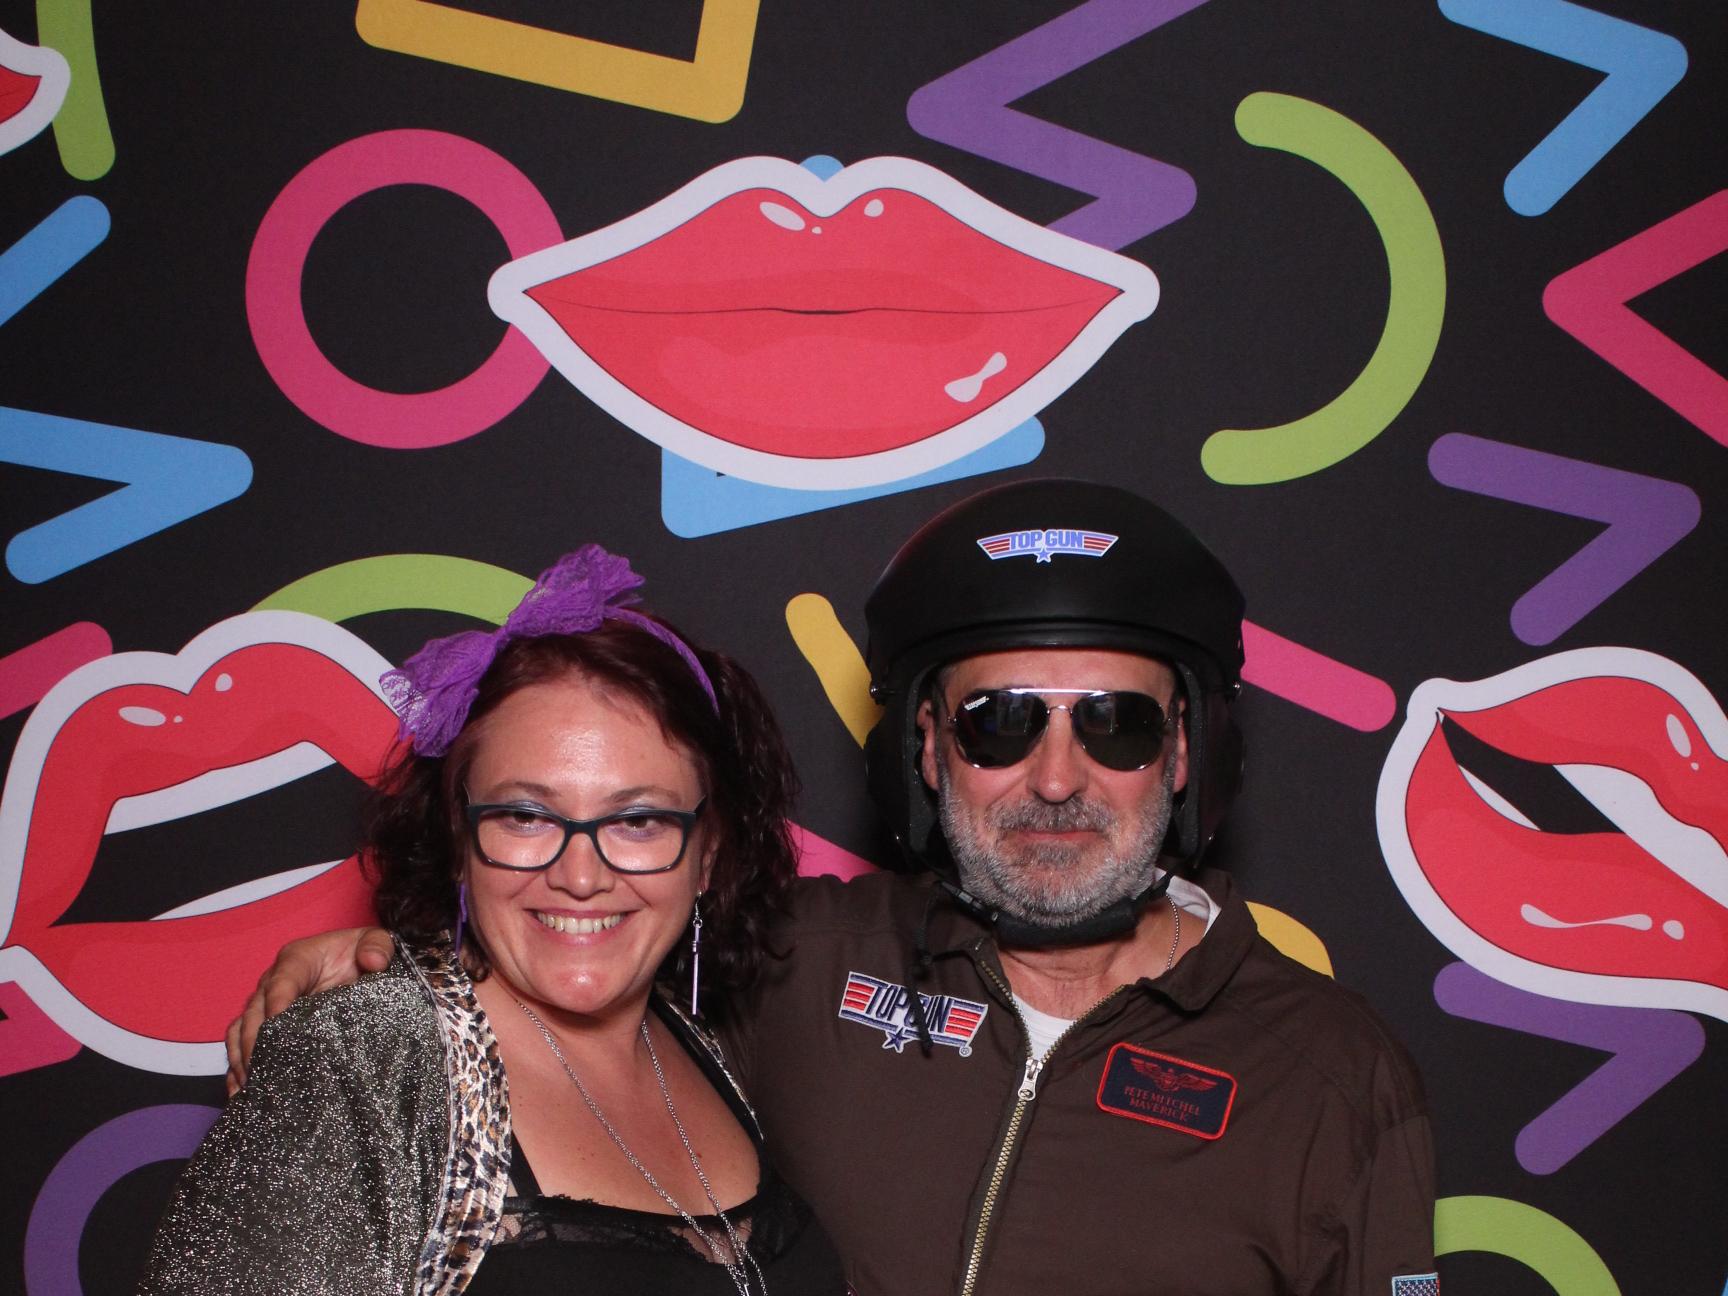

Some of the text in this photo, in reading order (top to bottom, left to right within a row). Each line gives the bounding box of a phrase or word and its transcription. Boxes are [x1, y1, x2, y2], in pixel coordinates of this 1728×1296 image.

[1010, 530, 1084, 550] TOP GUN
[865, 983, 910, 1022] TOP
[1123, 1085, 1150, 1101] PETE
[1129, 1097, 1188, 1122] MAVERICK
